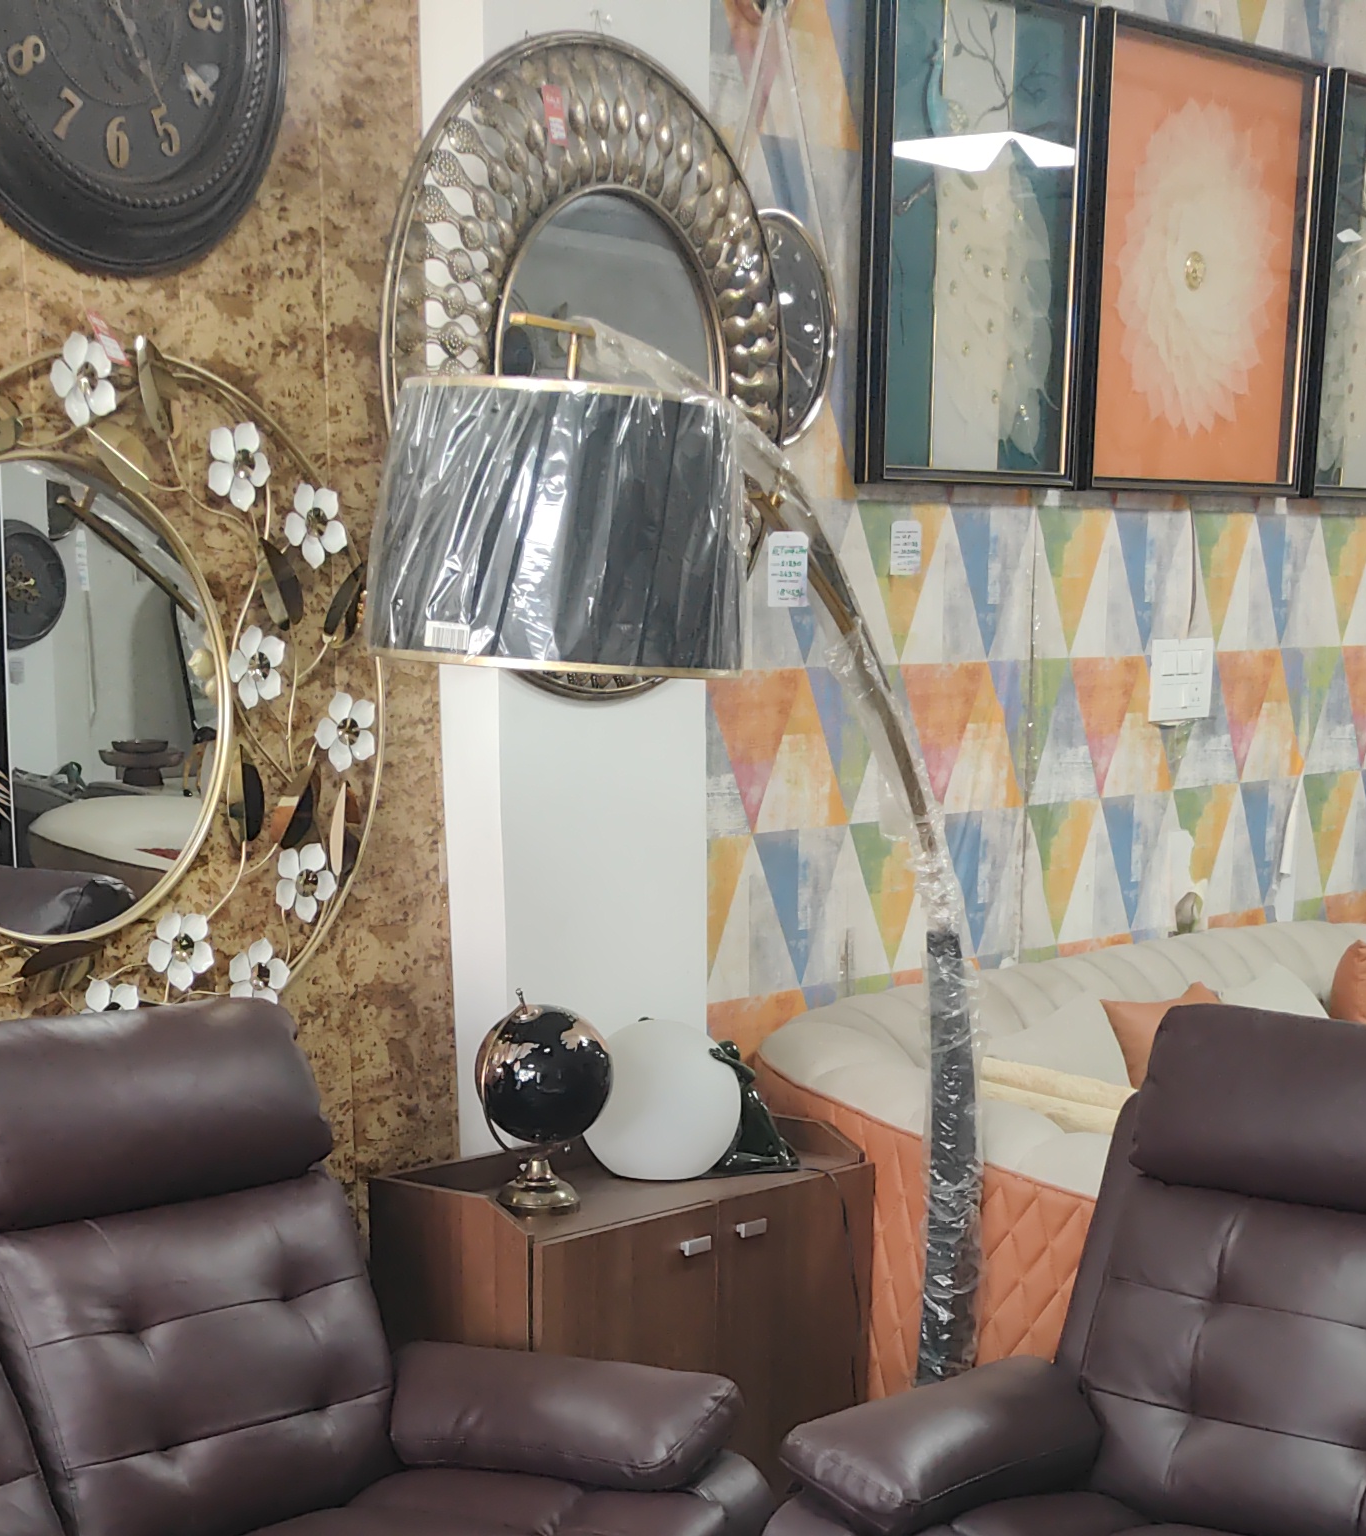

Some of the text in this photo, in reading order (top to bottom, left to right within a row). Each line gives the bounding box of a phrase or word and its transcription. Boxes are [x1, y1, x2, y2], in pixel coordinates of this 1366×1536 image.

[188, 0, 224, 33] 3
[7, 35, 46, 76] 8
[183, 62, 216, 108] 4
[52, 86, 83, 140] 7
[151, 102, 180, 157] 5
[106, 116, 130, 169] 6
